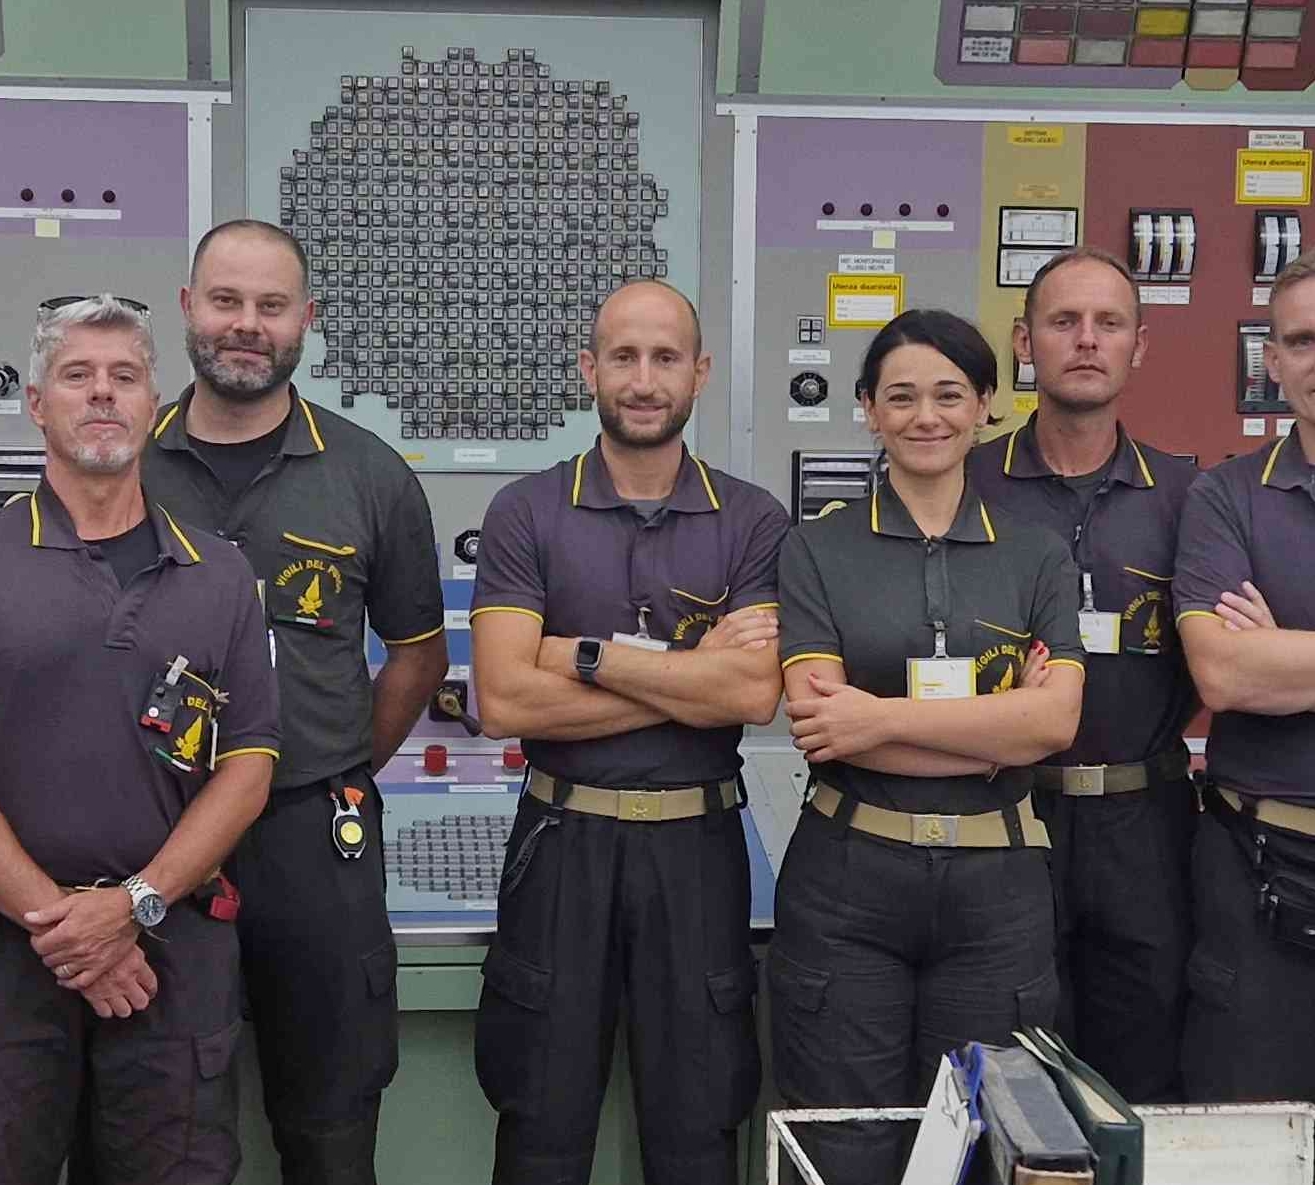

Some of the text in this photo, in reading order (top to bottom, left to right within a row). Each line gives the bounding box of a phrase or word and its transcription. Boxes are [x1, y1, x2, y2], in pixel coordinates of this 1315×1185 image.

[275, 561, 303, 587] VIGILI
[306, 559, 325, 571] DEL
[673, 614, 694, 640] VIGILI
[187, 696, 208, 711] DEL
